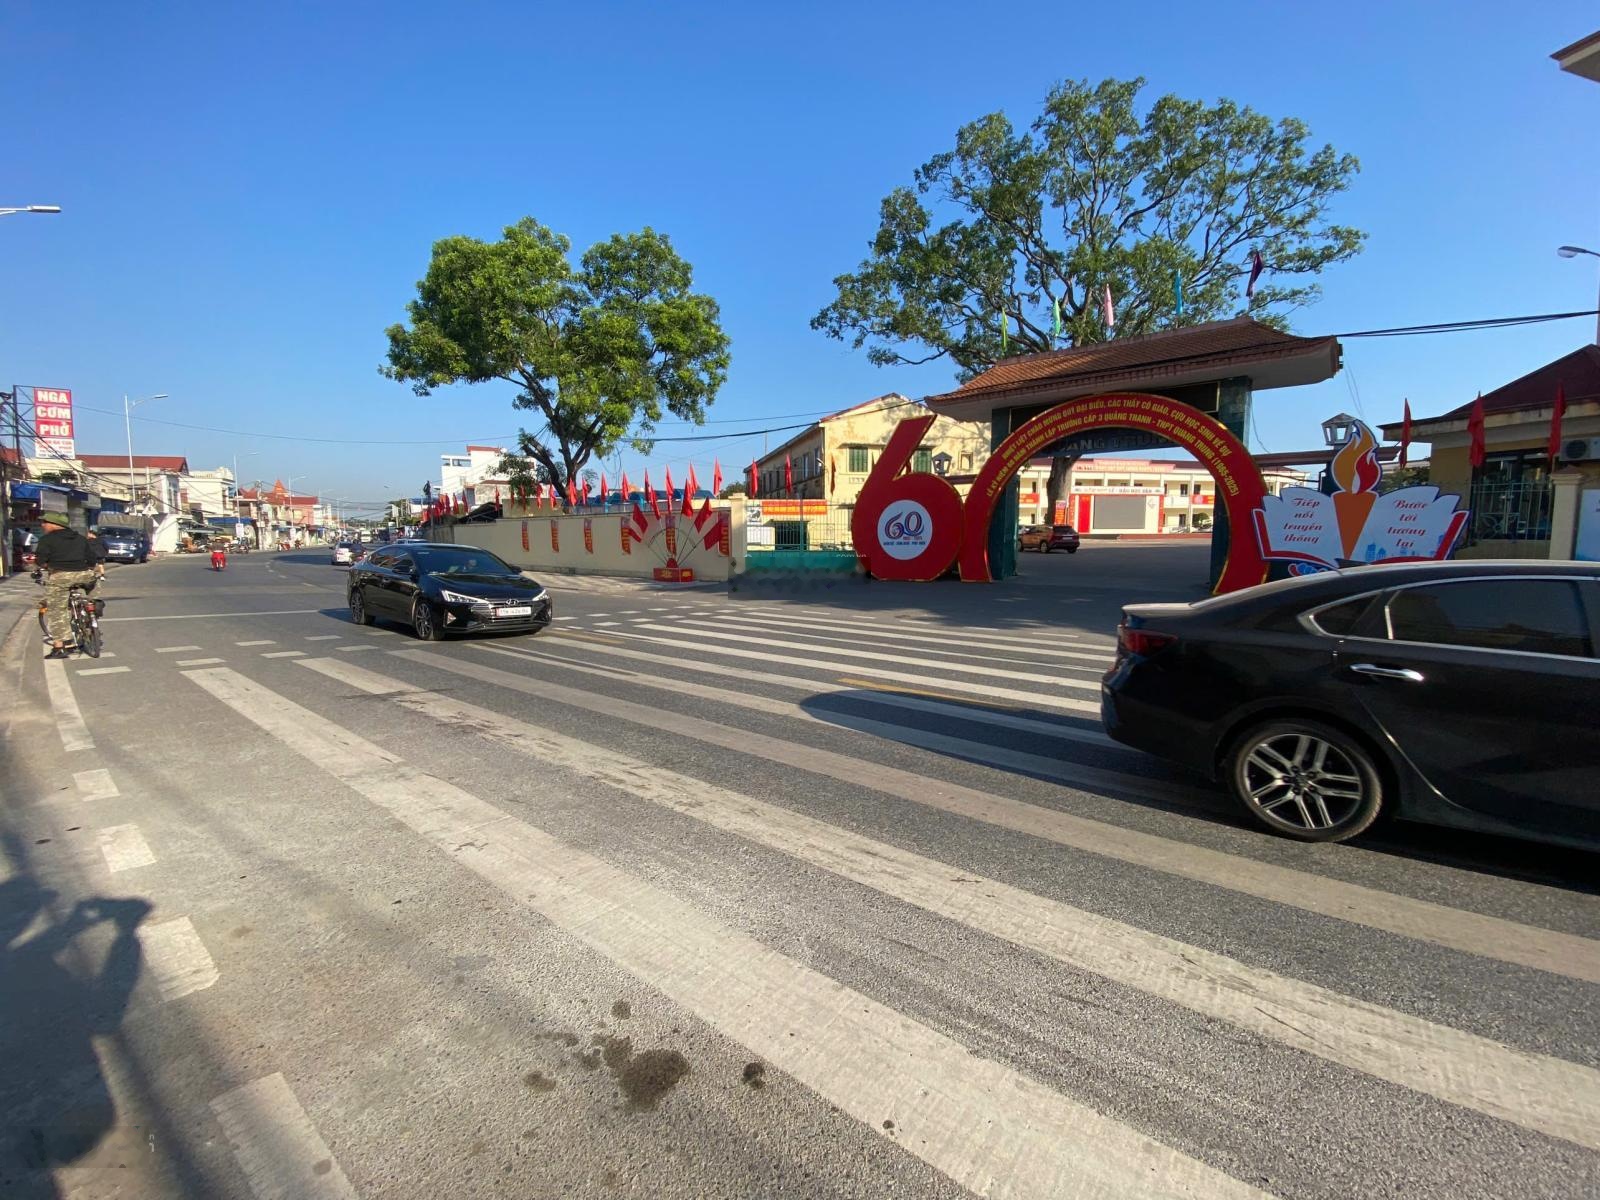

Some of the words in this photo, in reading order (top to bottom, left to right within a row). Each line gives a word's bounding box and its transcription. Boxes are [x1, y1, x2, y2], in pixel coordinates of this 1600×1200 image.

[37, 390, 68, 403] NGA
[1141, 400, 1152, 410] CÔ
[36, 405, 71, 420] CƠM
[39, 420, 70, 436] PHỞ
[1156, 419, 1175, 432] THPT
[1291, 497, 1320, 508] Tiếp
[1394, 499, 1428, 509] Bước
[1294, 510, 1314, 519] nối
[1399, 512, 1417, 521] tới
[1283, 522, 1323, 532] truyền
[1387, 526, 1426, 537] tương
[1284, 533, 1320, 544] thống
